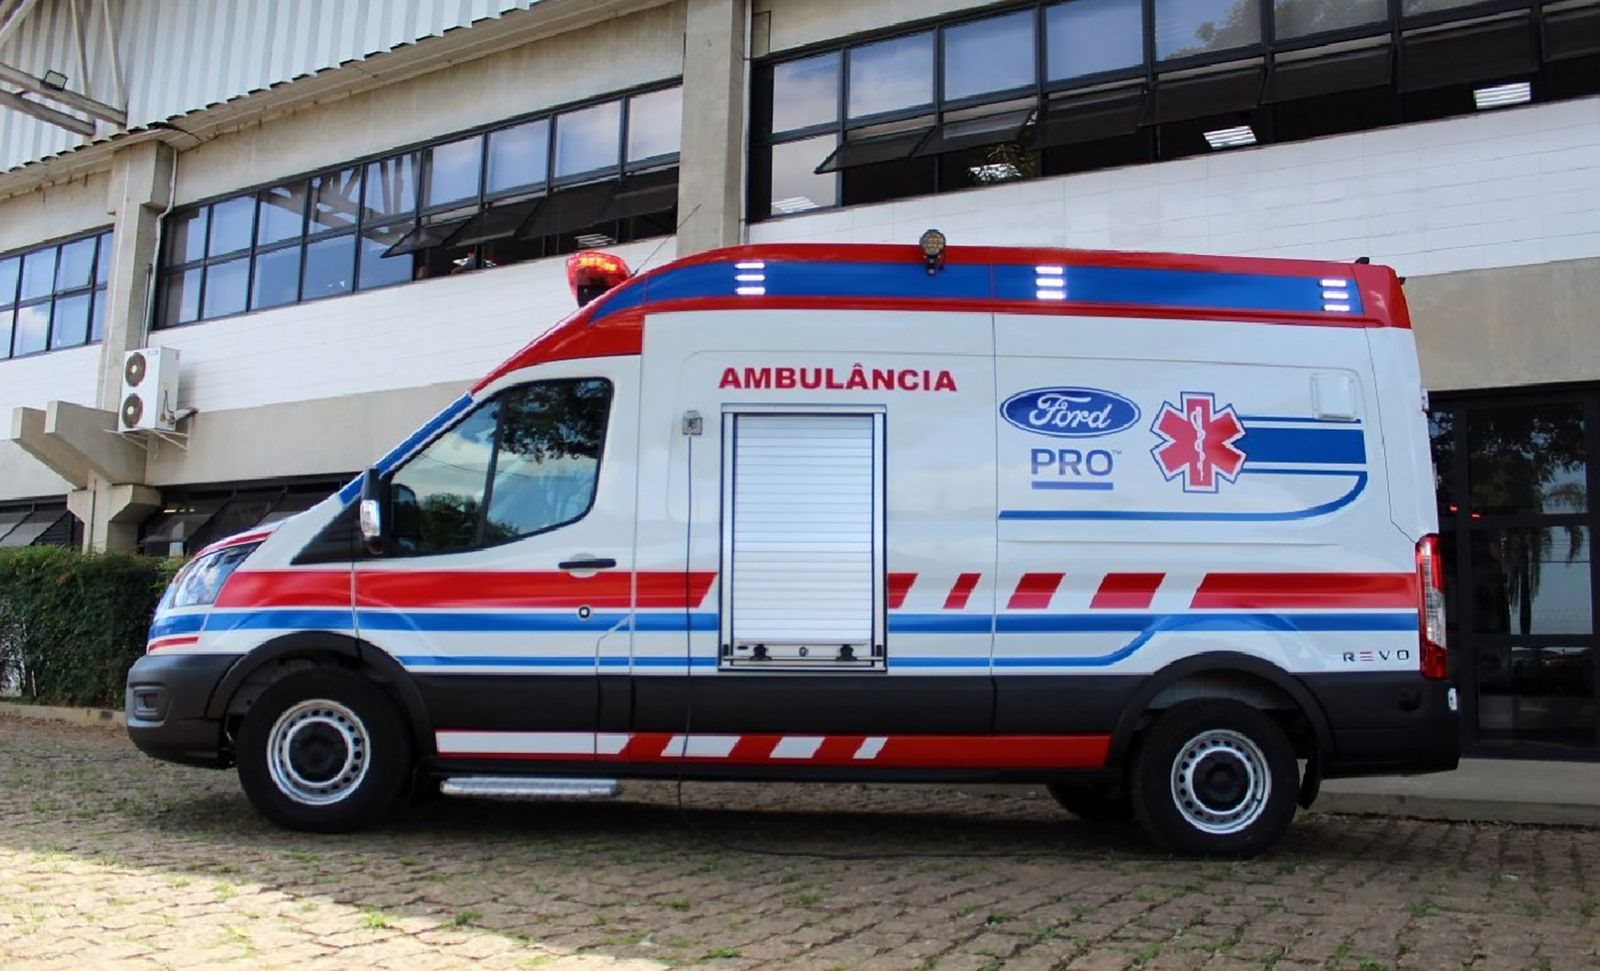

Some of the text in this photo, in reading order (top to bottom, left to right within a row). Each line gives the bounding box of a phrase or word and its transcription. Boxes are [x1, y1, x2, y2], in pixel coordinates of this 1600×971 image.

[718, 362, 958, 391] AMBULÂNCIA
[1029, 394, 1112, 428] Ford
[1343, 649, 1410, 662] REVO
